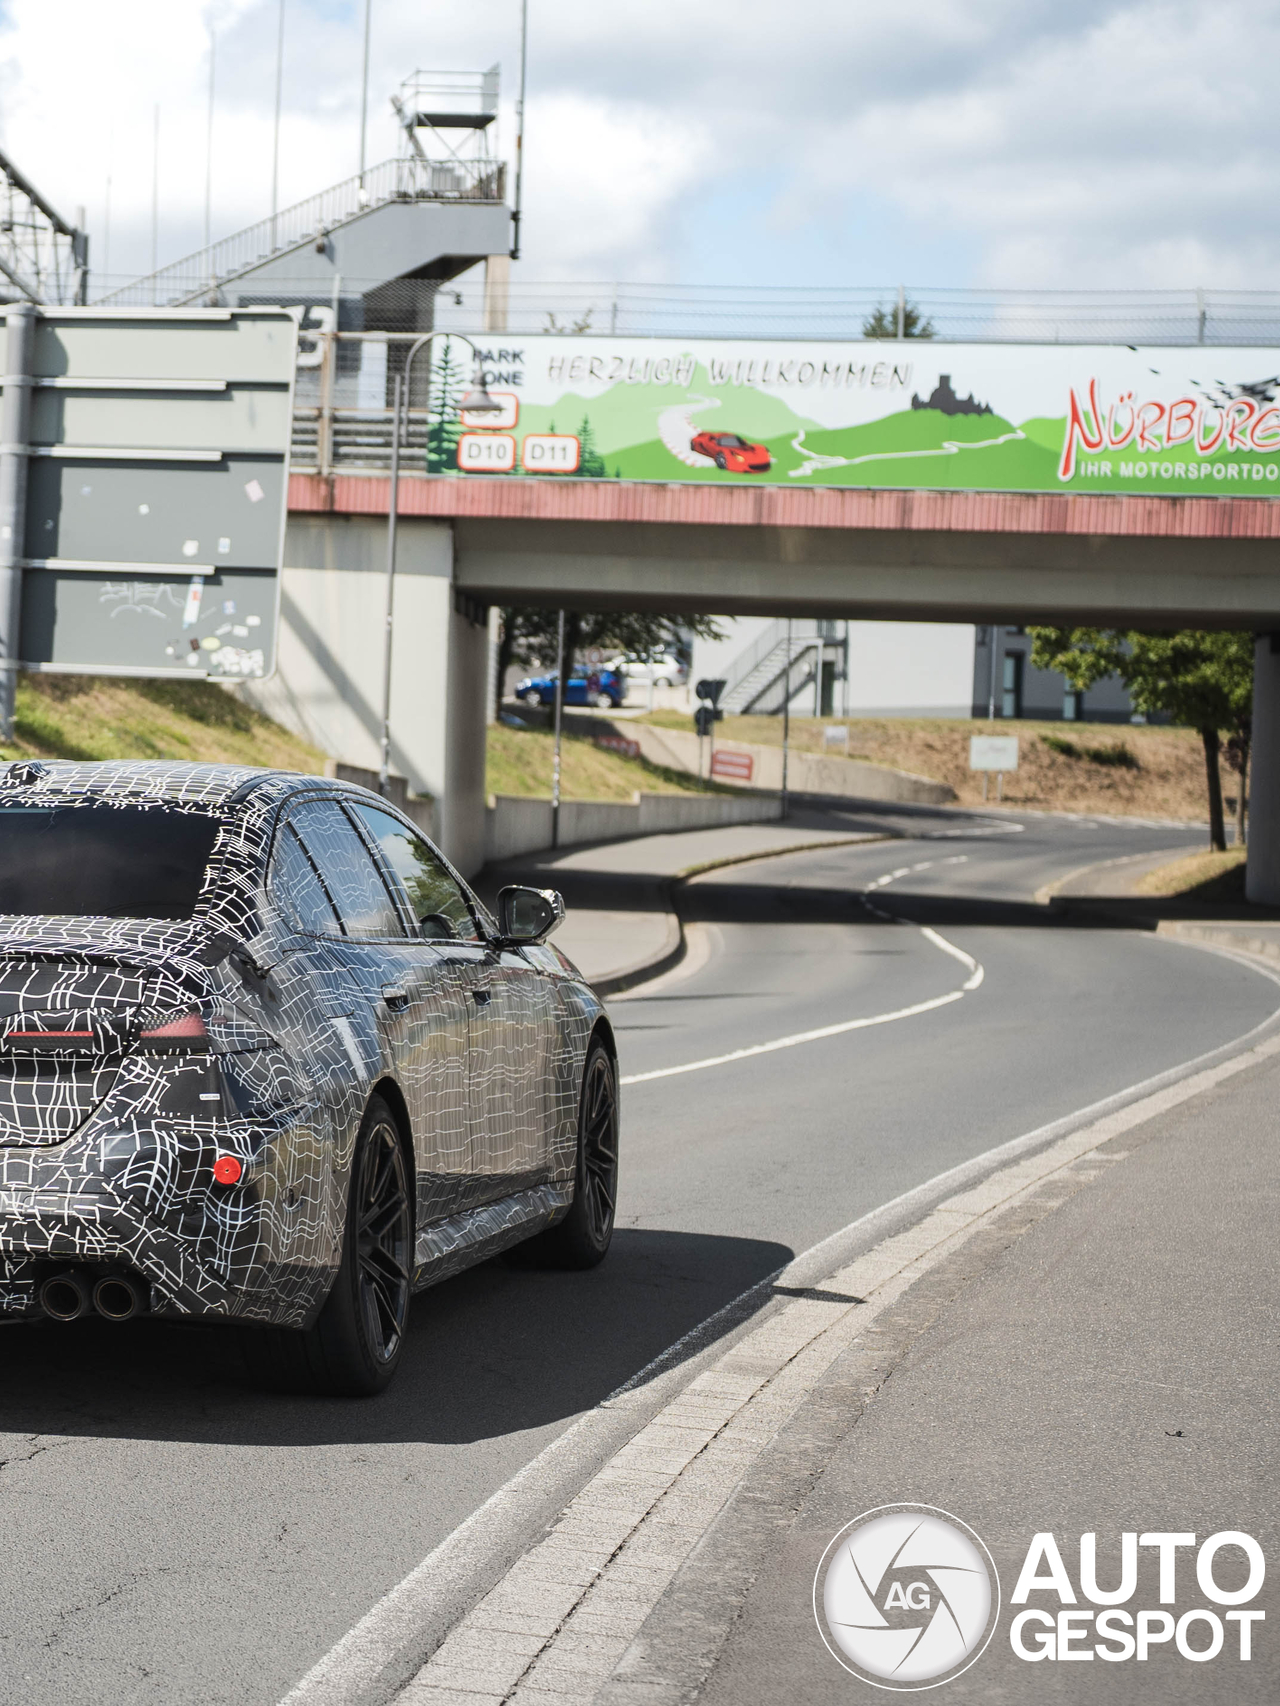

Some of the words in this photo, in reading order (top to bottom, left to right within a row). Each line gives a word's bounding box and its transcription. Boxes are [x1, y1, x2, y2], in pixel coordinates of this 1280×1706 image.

[472, 370, 524, 386] ONE
[548, 355, 696, 386] HERZLICH
[709, 357, 912, 388] WILLKOMMEN
[467, 442, 508, 460] D10
[530, 443, 569, 461] D11
[1080, 460, 1113, 478] IHR
